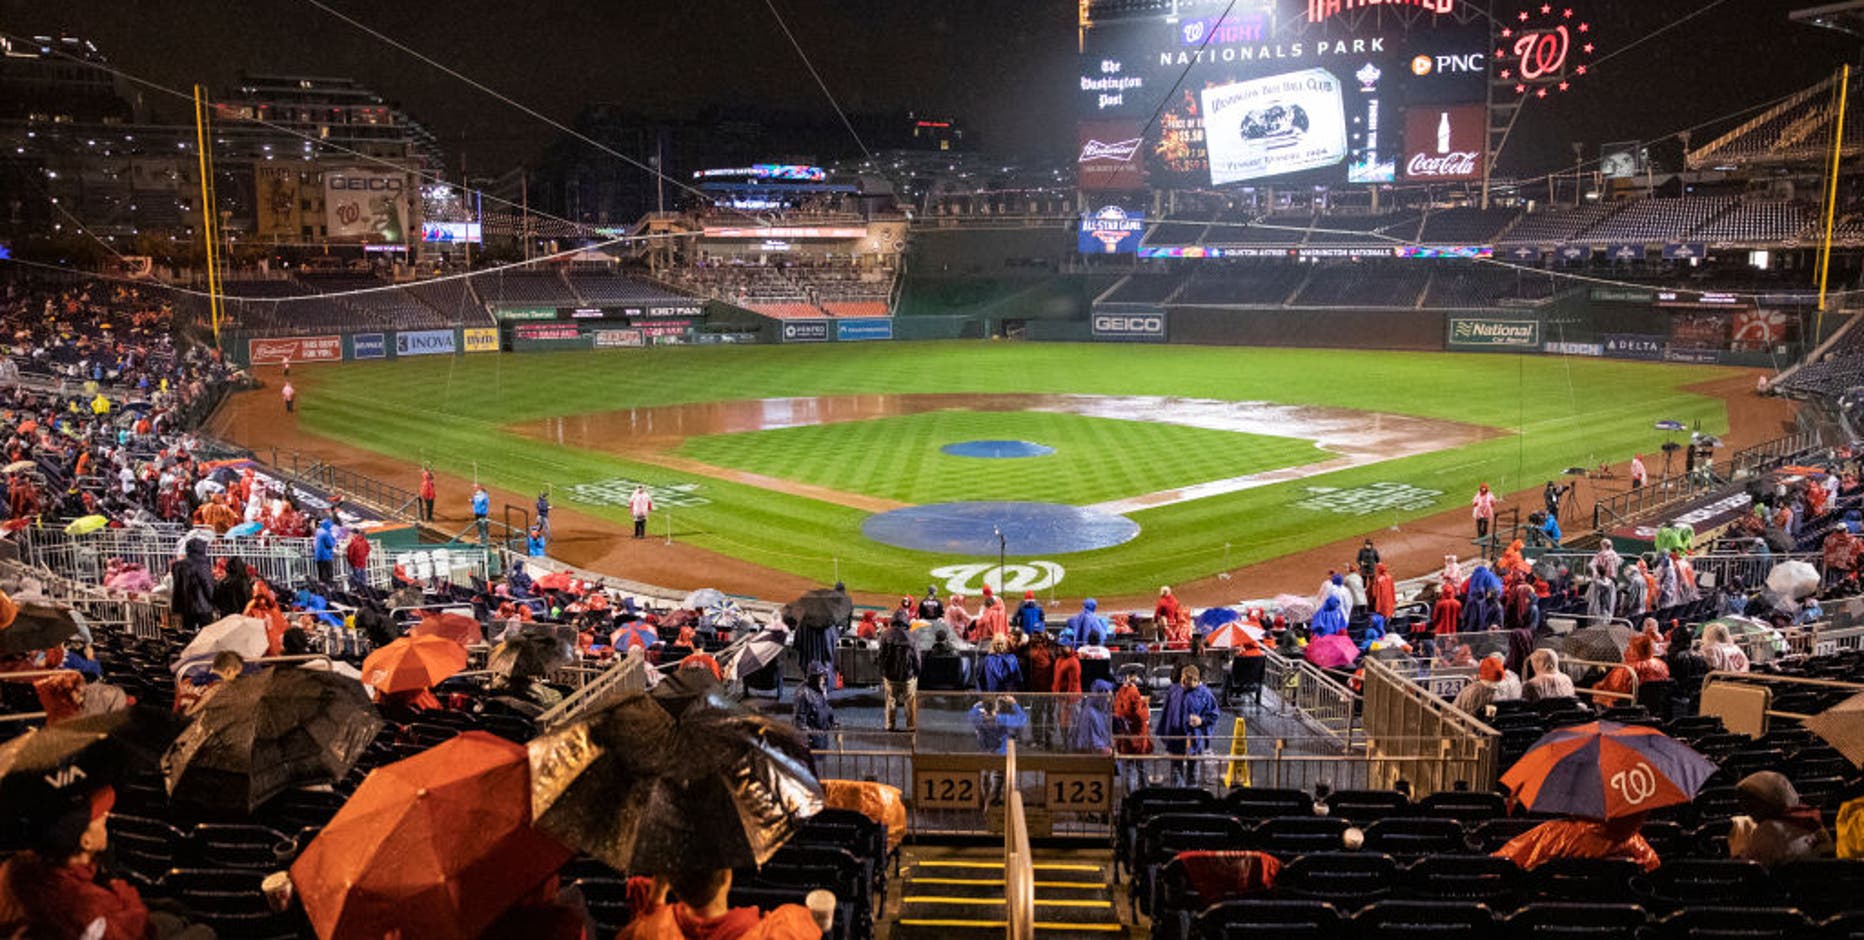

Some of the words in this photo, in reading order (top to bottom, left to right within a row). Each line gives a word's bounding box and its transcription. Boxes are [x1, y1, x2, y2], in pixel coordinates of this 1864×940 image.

[1160, 44, 1302, 66] NATIONALS
[1317, 37, 1384, 56] PARK
[1101, 60, 1121, 73] The
[1435, 53, 1484, 73] PNC
[1081, 76, 1142, 91] Washington
[1099, 93, 1122, 109] Post
[330, 178, 402, 190] GEICO
[1120, 219, 1142, 230] GAME
[1096, 317, 1160, 331] GEICO
[1472, 323, 1534, 337] National
[411, 335, 453, 349] INOVA
[1619, 341, 1658, 351] DELTA
[923, 779, 974, 801] 122
[1054, 781, 1105, 803] 123
